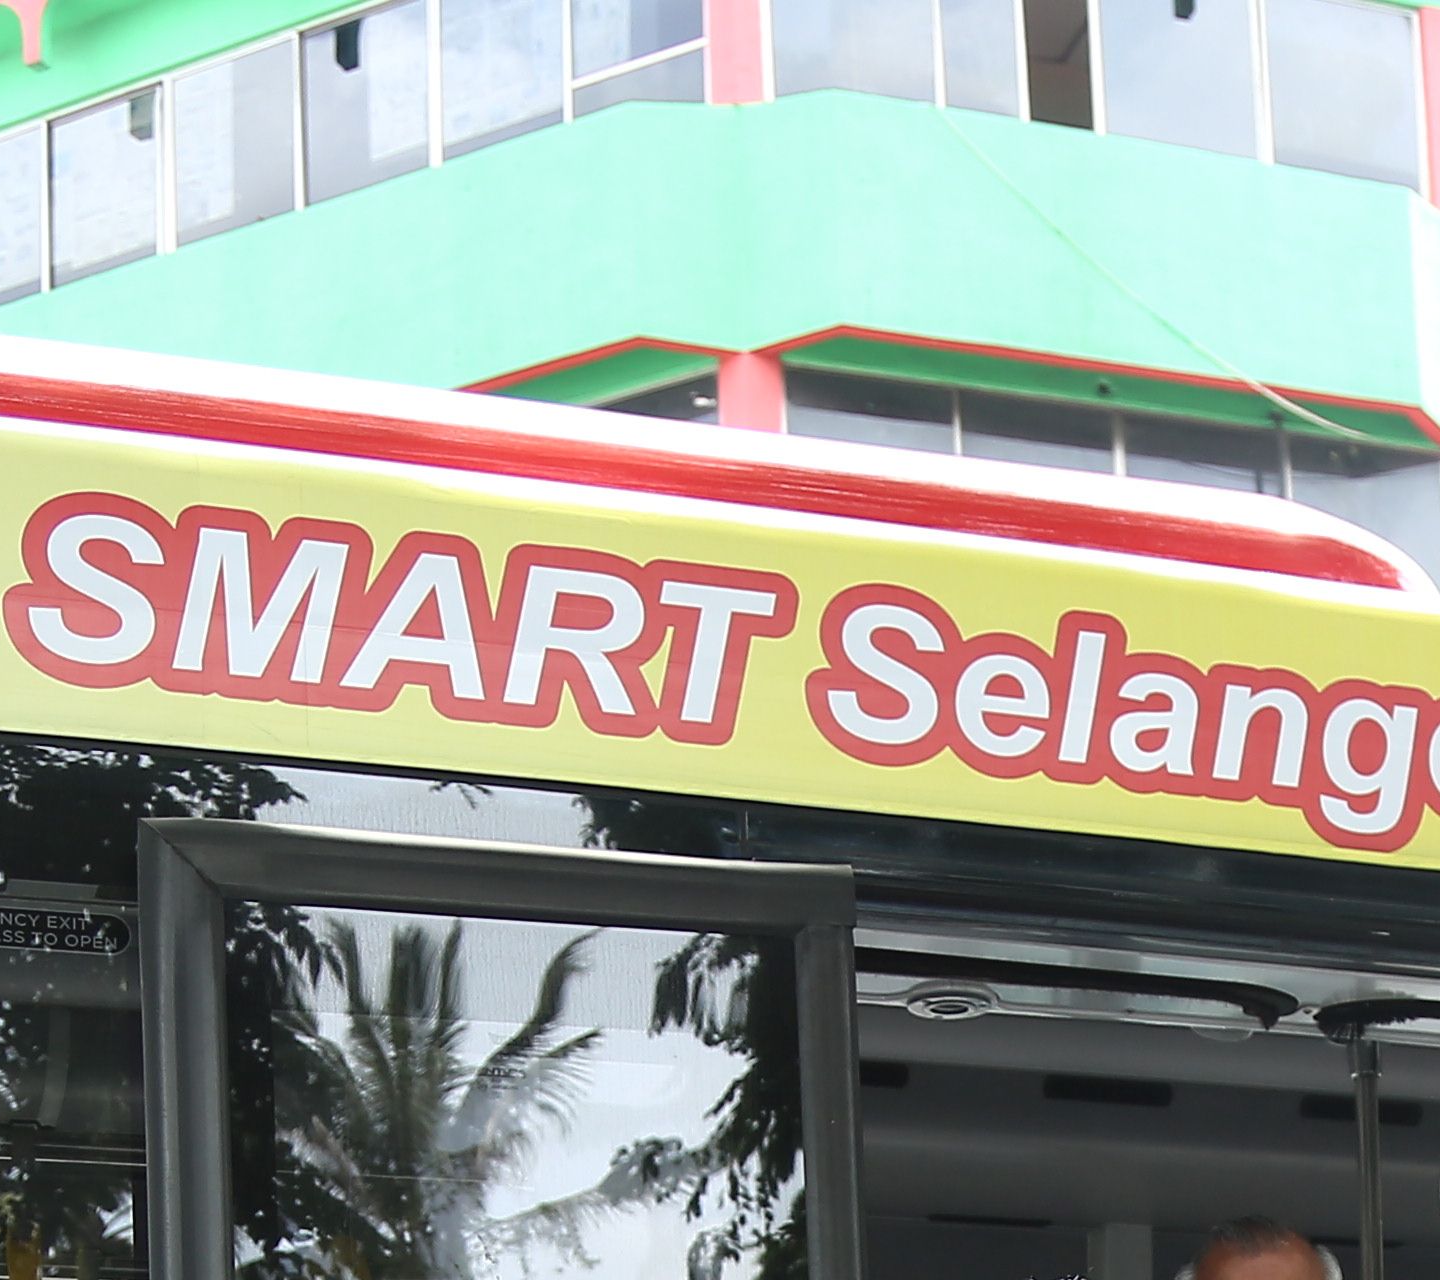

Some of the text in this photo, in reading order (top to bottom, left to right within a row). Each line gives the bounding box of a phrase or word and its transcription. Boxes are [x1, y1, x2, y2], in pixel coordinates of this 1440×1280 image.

[18, 502, 782, 732] SMART
[47, 914, 88, 931] EXIT
[32, 931, 58, 947] TO
[64, 934, 118, 950] OPEN
